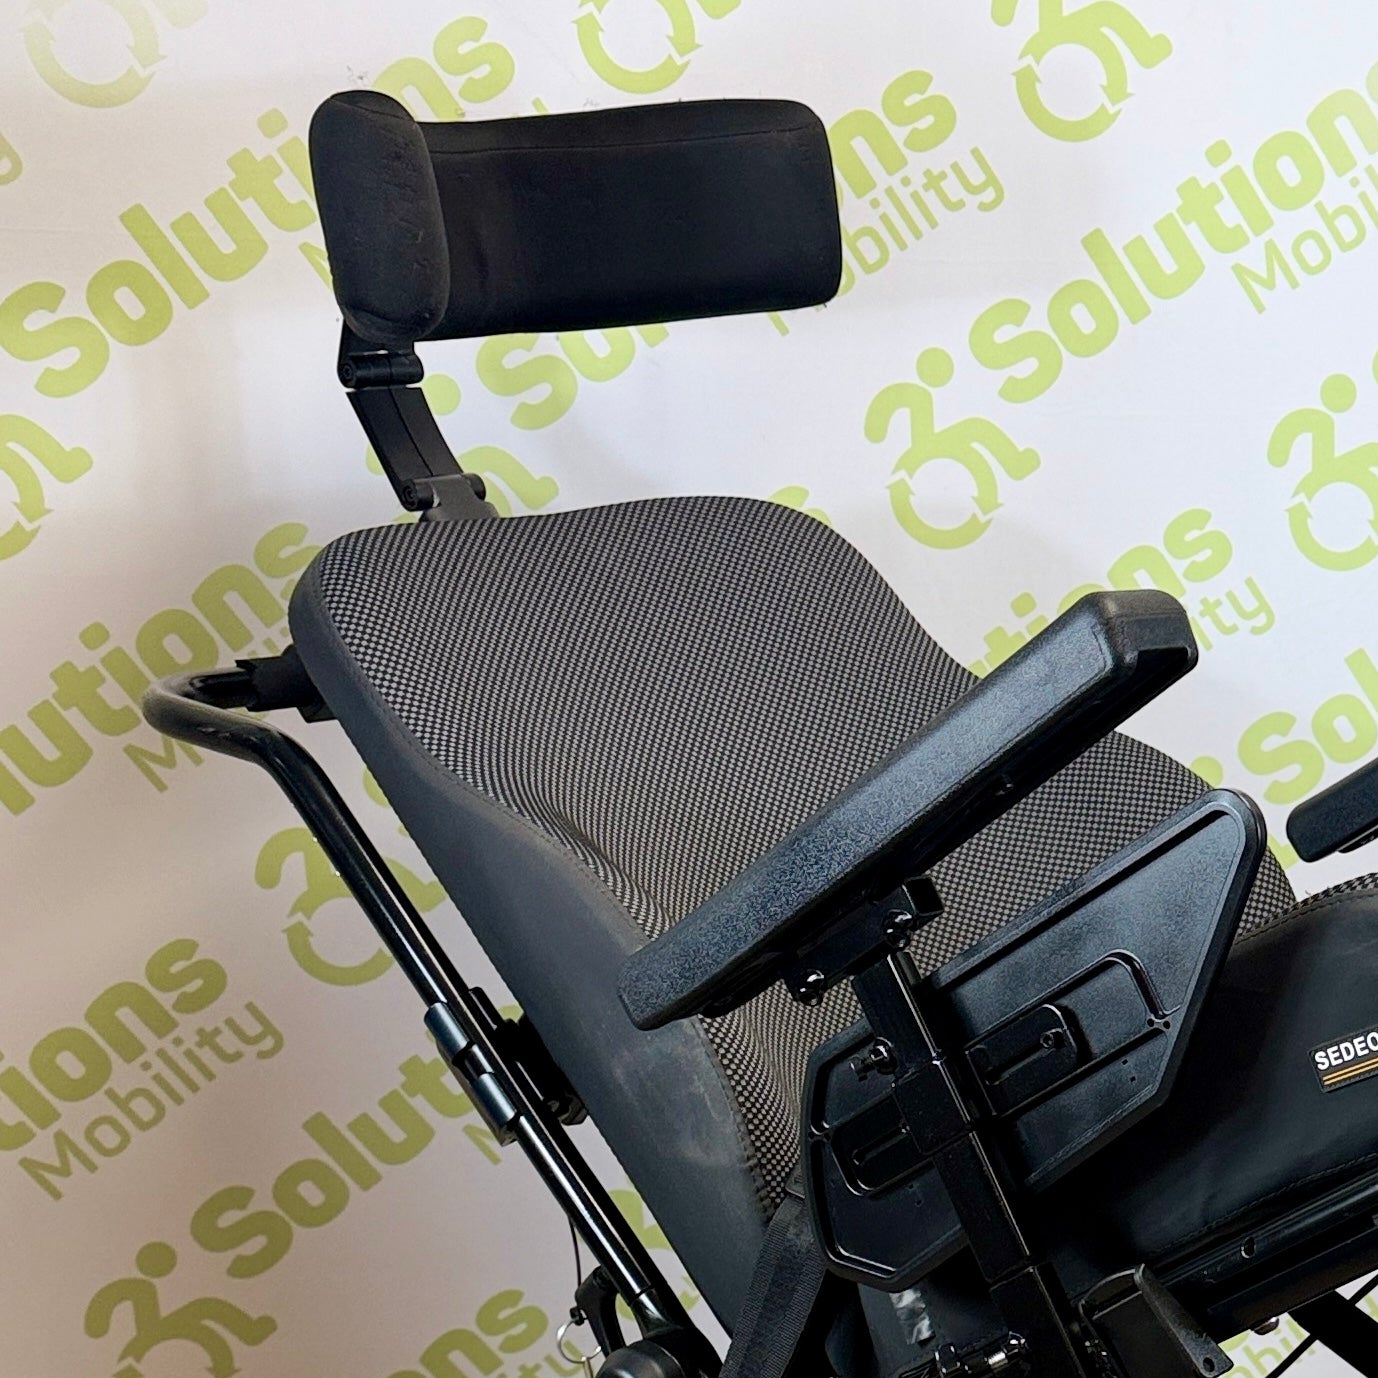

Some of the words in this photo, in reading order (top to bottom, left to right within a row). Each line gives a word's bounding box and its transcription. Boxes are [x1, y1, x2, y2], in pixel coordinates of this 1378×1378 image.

[2, 15, 515, 398] Solutins
[768, 146, 1005, 336] bility
[18, 1001, 285, 1202] Mobility
